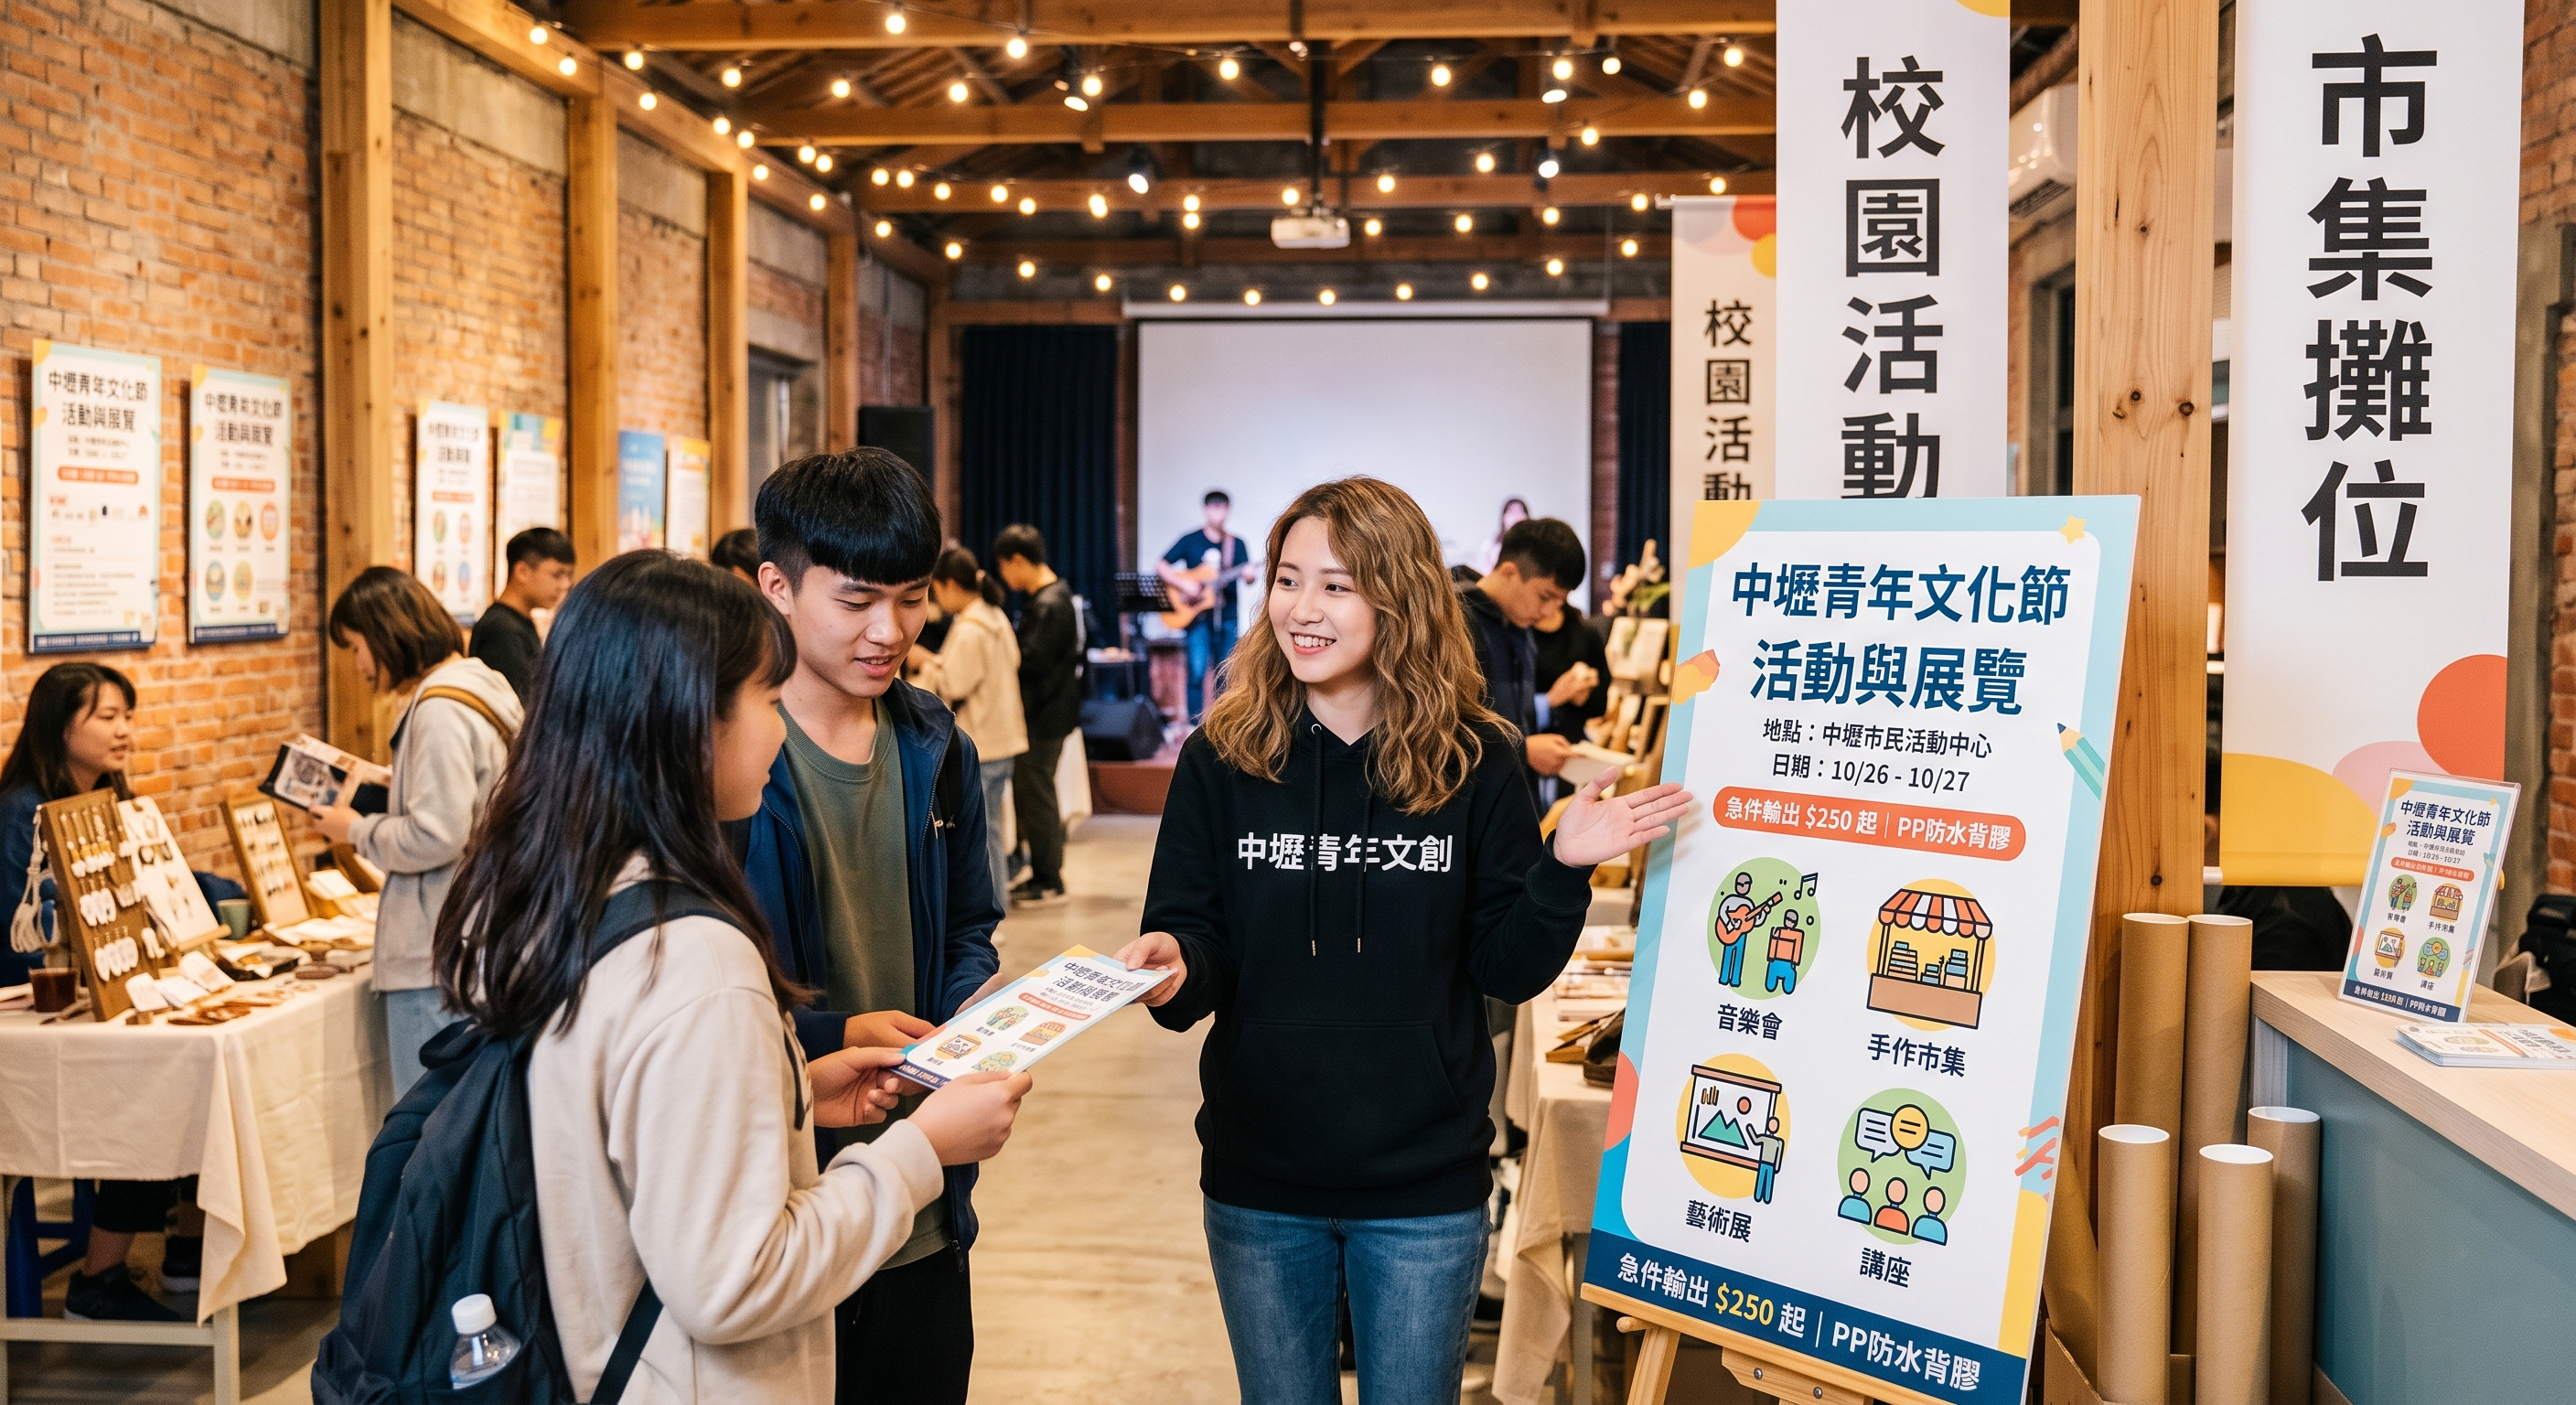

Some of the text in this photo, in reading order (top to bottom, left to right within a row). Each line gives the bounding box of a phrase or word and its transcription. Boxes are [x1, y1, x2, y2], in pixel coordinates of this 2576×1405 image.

[1841, 55, 1946, 499] 校園活動
[2301, 33, 2438, 583] 市集攤位
[1732, 562, 2071, 626] 中壢青年文化節
[1750, 638, 2027, 715] 活動與展覽
[1908, 766, 1970, 794] 10/27
[1725, 796, 2012, 852] 急件輸出 $250 起 PP防水背膠
[1238, 831, 1453, 873] 中壢青年文創
[1717, 1003, 1783, 1041] 音樂會
[1867, 1033, 1967, 1078] 手作市集
[1685, 1199, 1752, 1243] 藝術展
[1860, 1247, 1912, 1289] 講座
[1616, 1251, 1981, 1393] 急件輸出 $250 起 PP防水背膠
